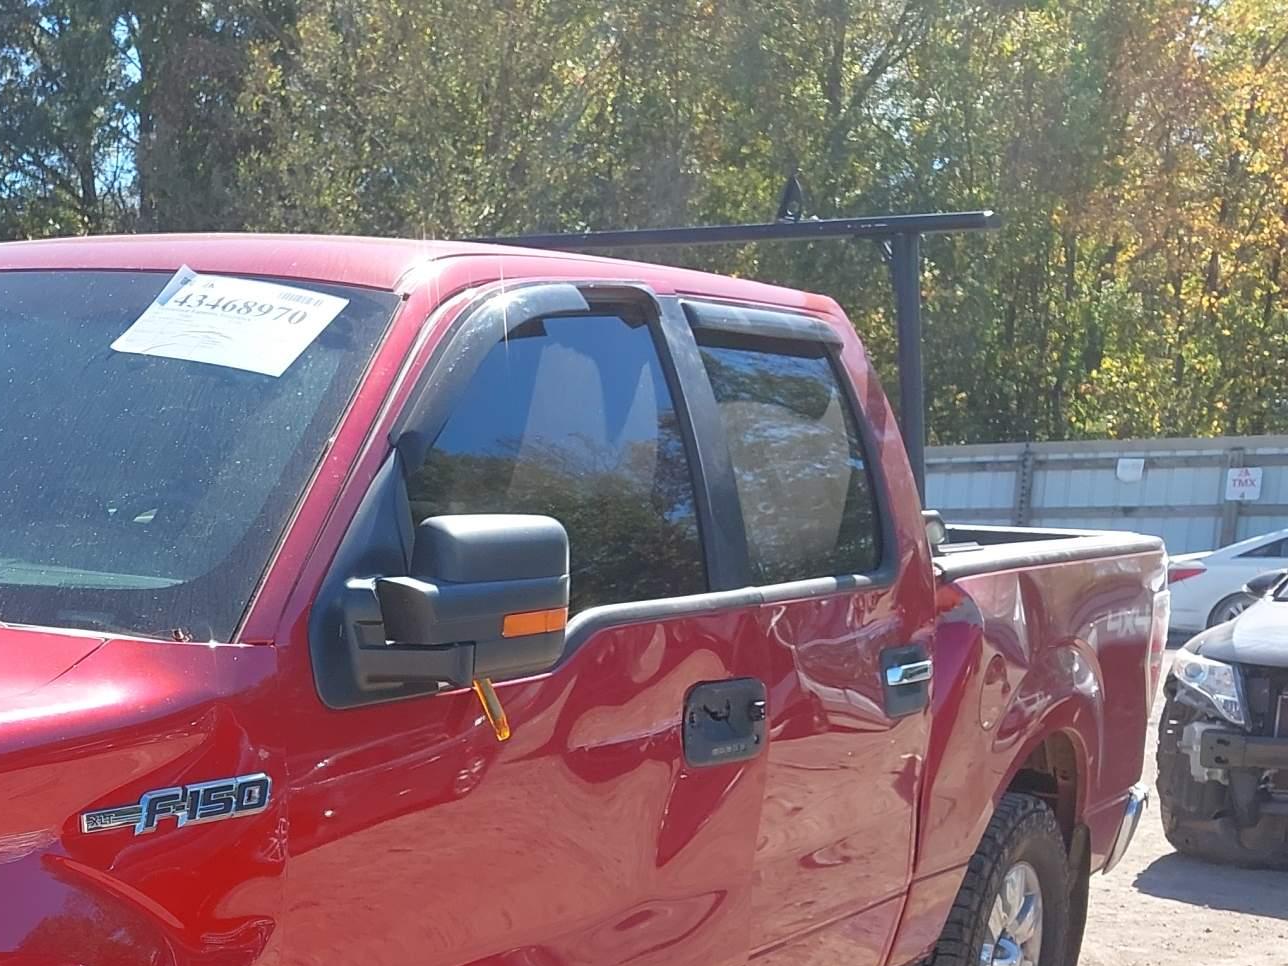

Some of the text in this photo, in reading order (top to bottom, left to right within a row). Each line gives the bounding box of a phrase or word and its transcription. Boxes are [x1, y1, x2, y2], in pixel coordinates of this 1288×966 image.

[173, 292, 308, 326] 43468970
[1232, 476, 1257, 486] TMX
[87, 773, 271, 835] XLT F-150
